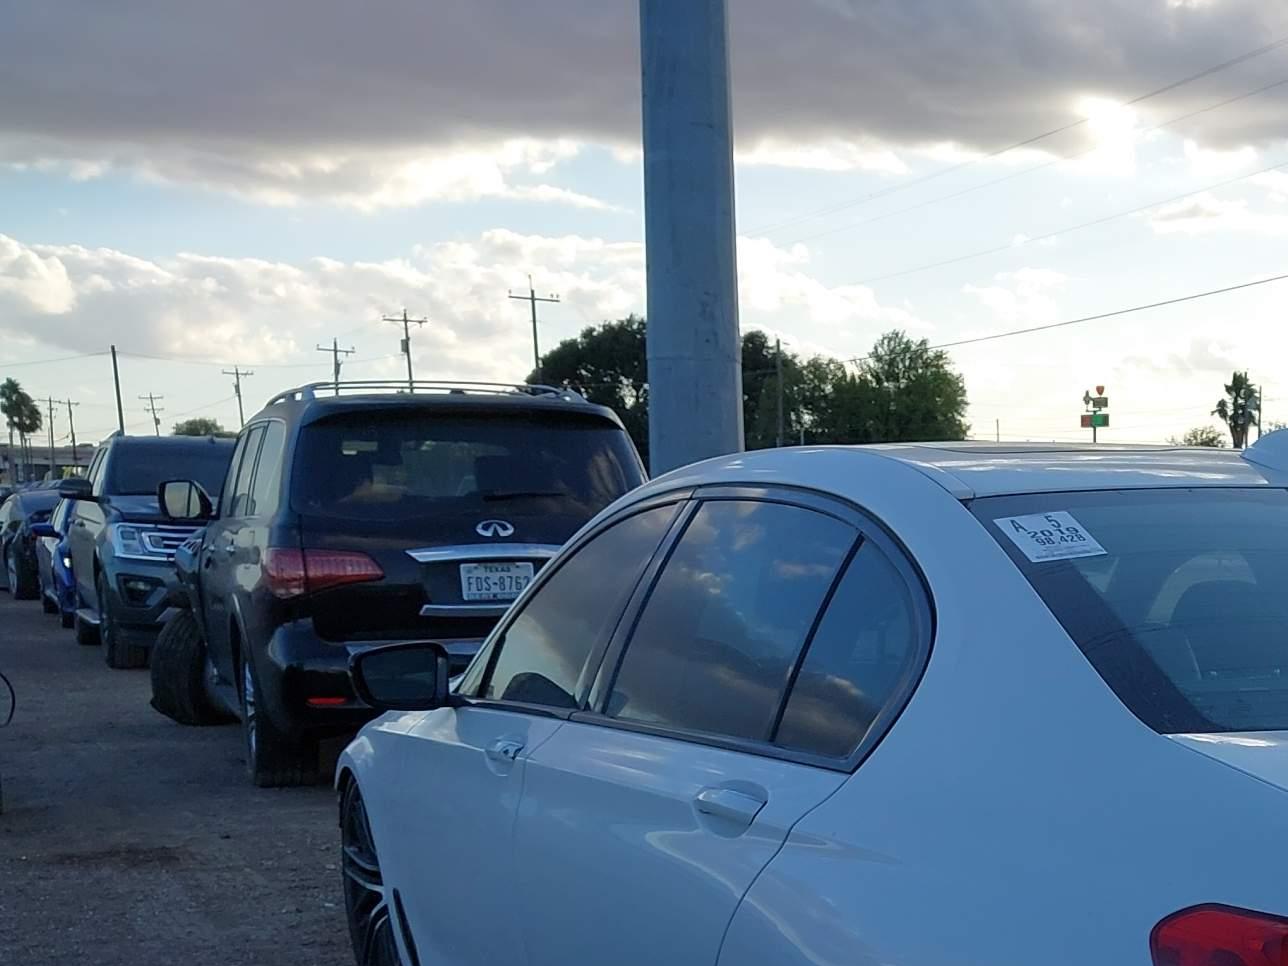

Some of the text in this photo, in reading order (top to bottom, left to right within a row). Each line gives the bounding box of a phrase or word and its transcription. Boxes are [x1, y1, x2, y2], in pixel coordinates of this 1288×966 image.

[1008, 514, 1062, 533] A 5
[1026, 526, 1080, 539] 2019
[483, 565, 512, 573] TEXAS
